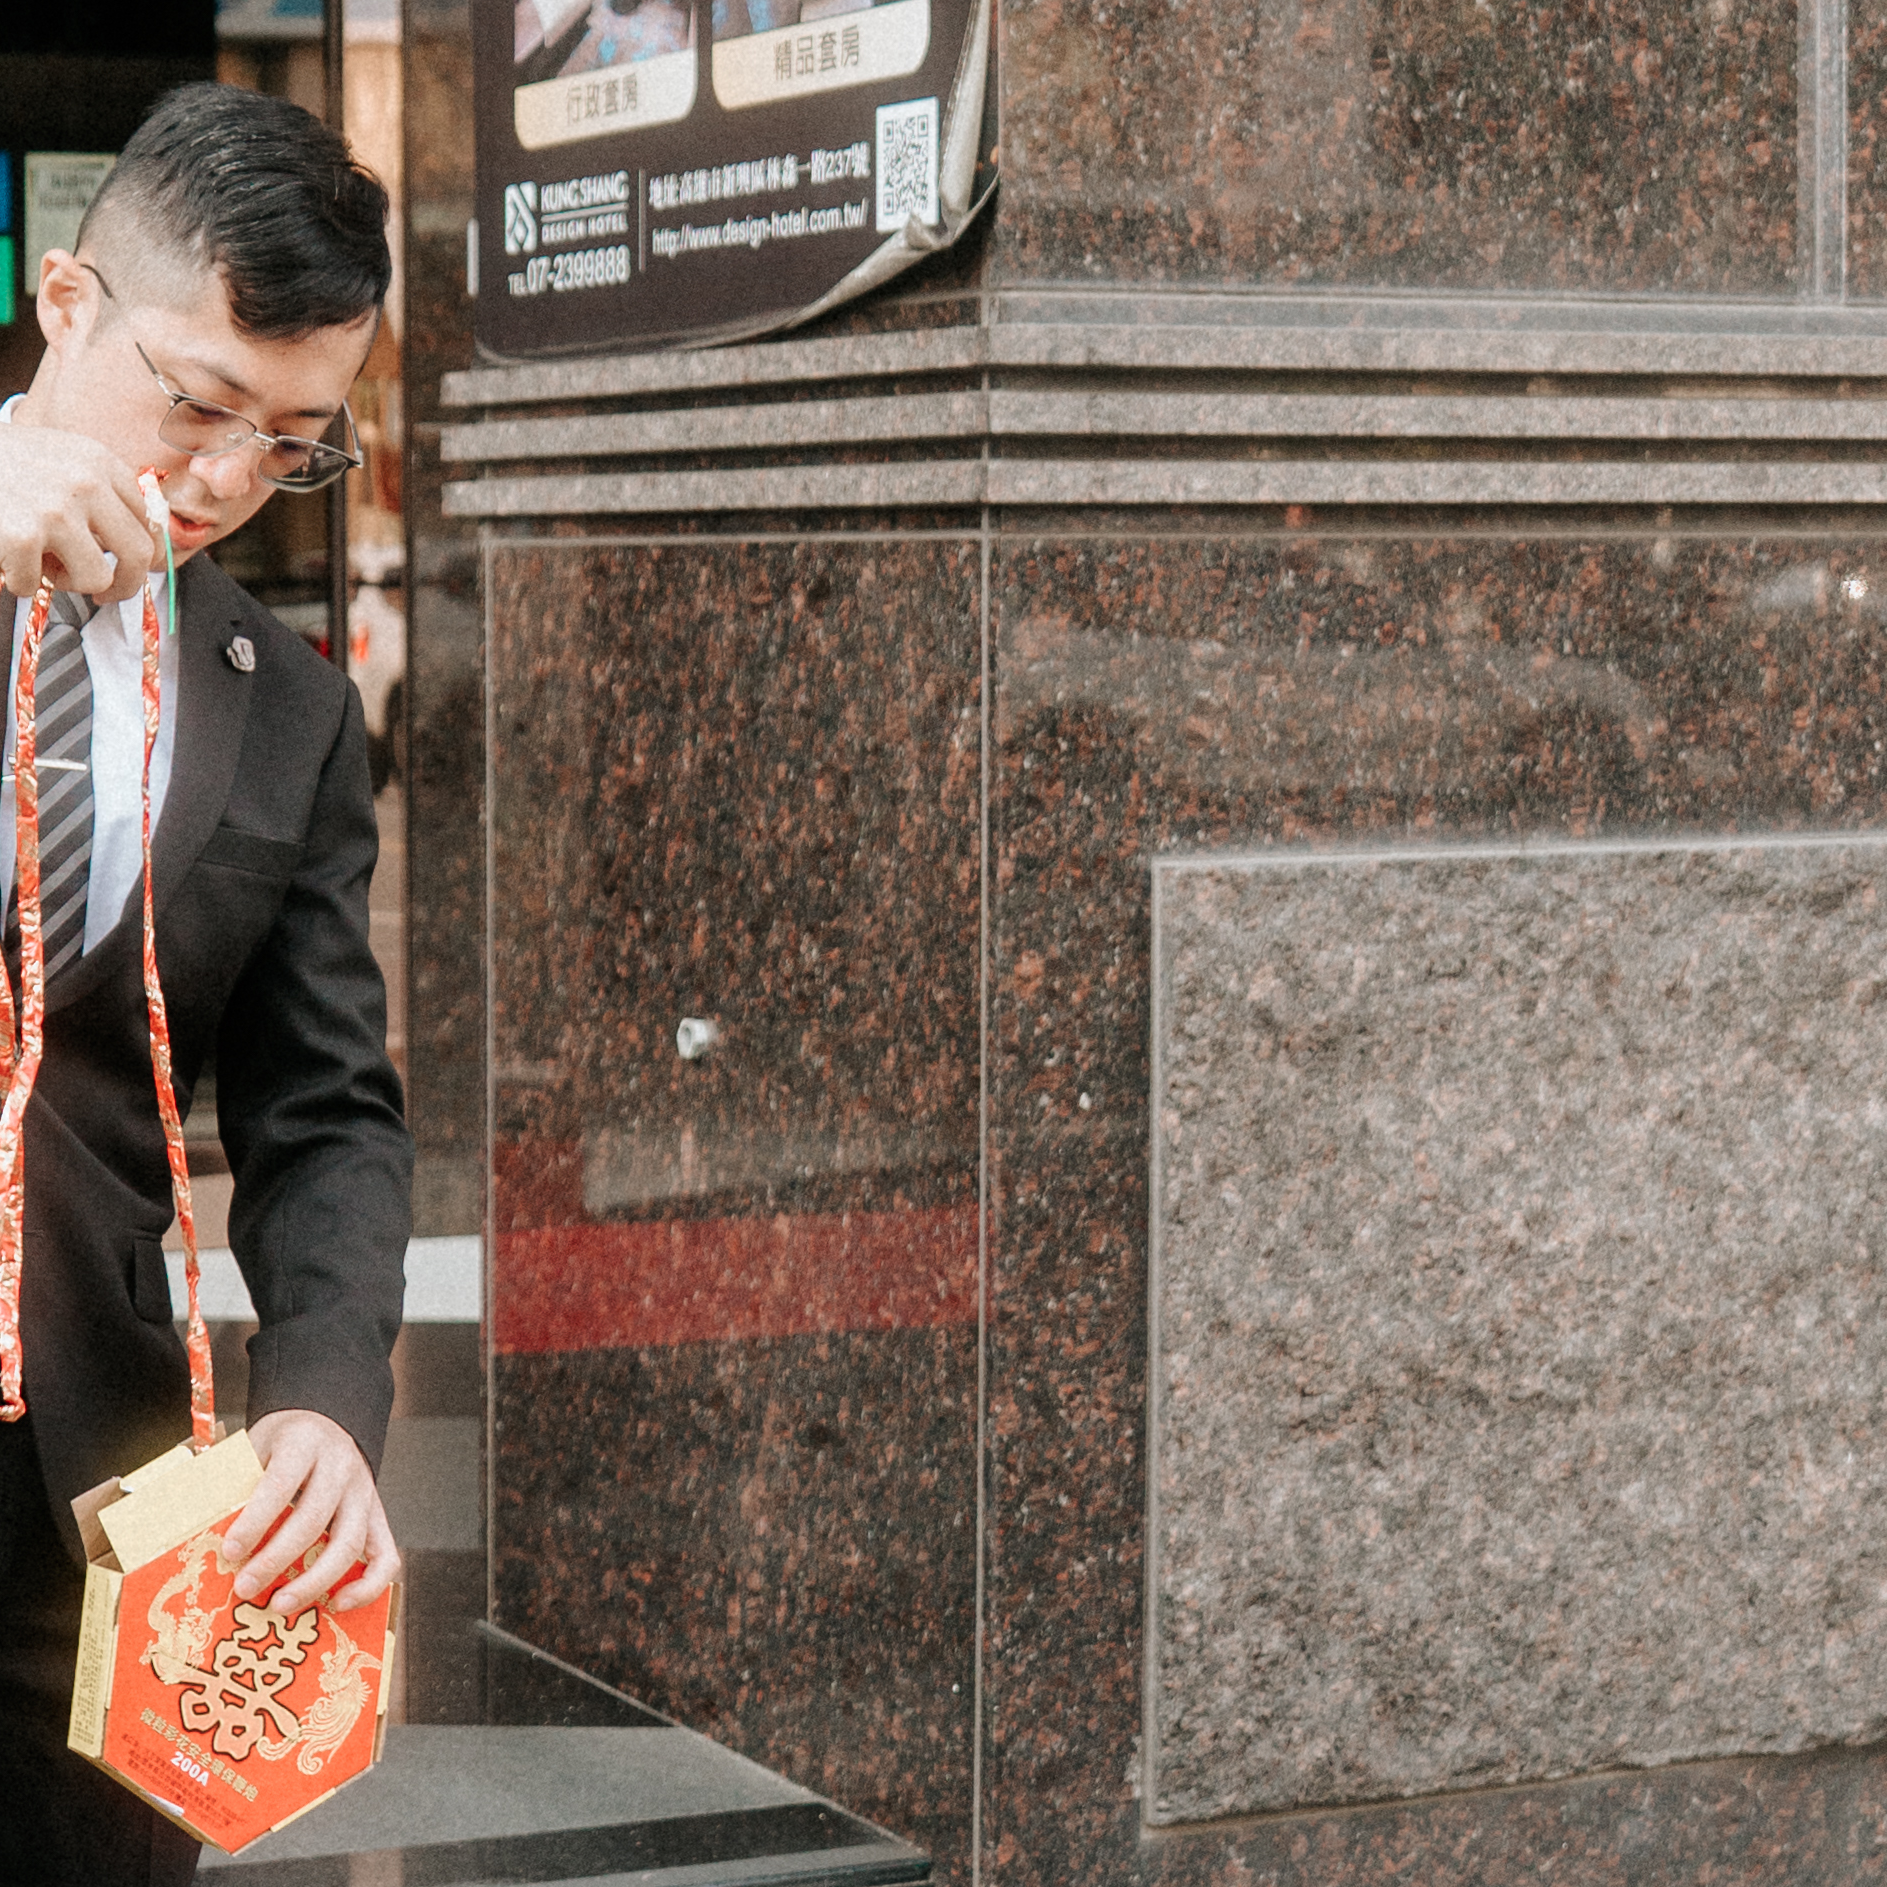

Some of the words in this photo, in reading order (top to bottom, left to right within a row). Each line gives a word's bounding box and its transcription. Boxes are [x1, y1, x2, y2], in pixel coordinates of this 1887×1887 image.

[773, 25, 860, 81] 精品套房
[566, 72, 639, 125] 行政套房
[170, 1751, 210, 1787] 200A
